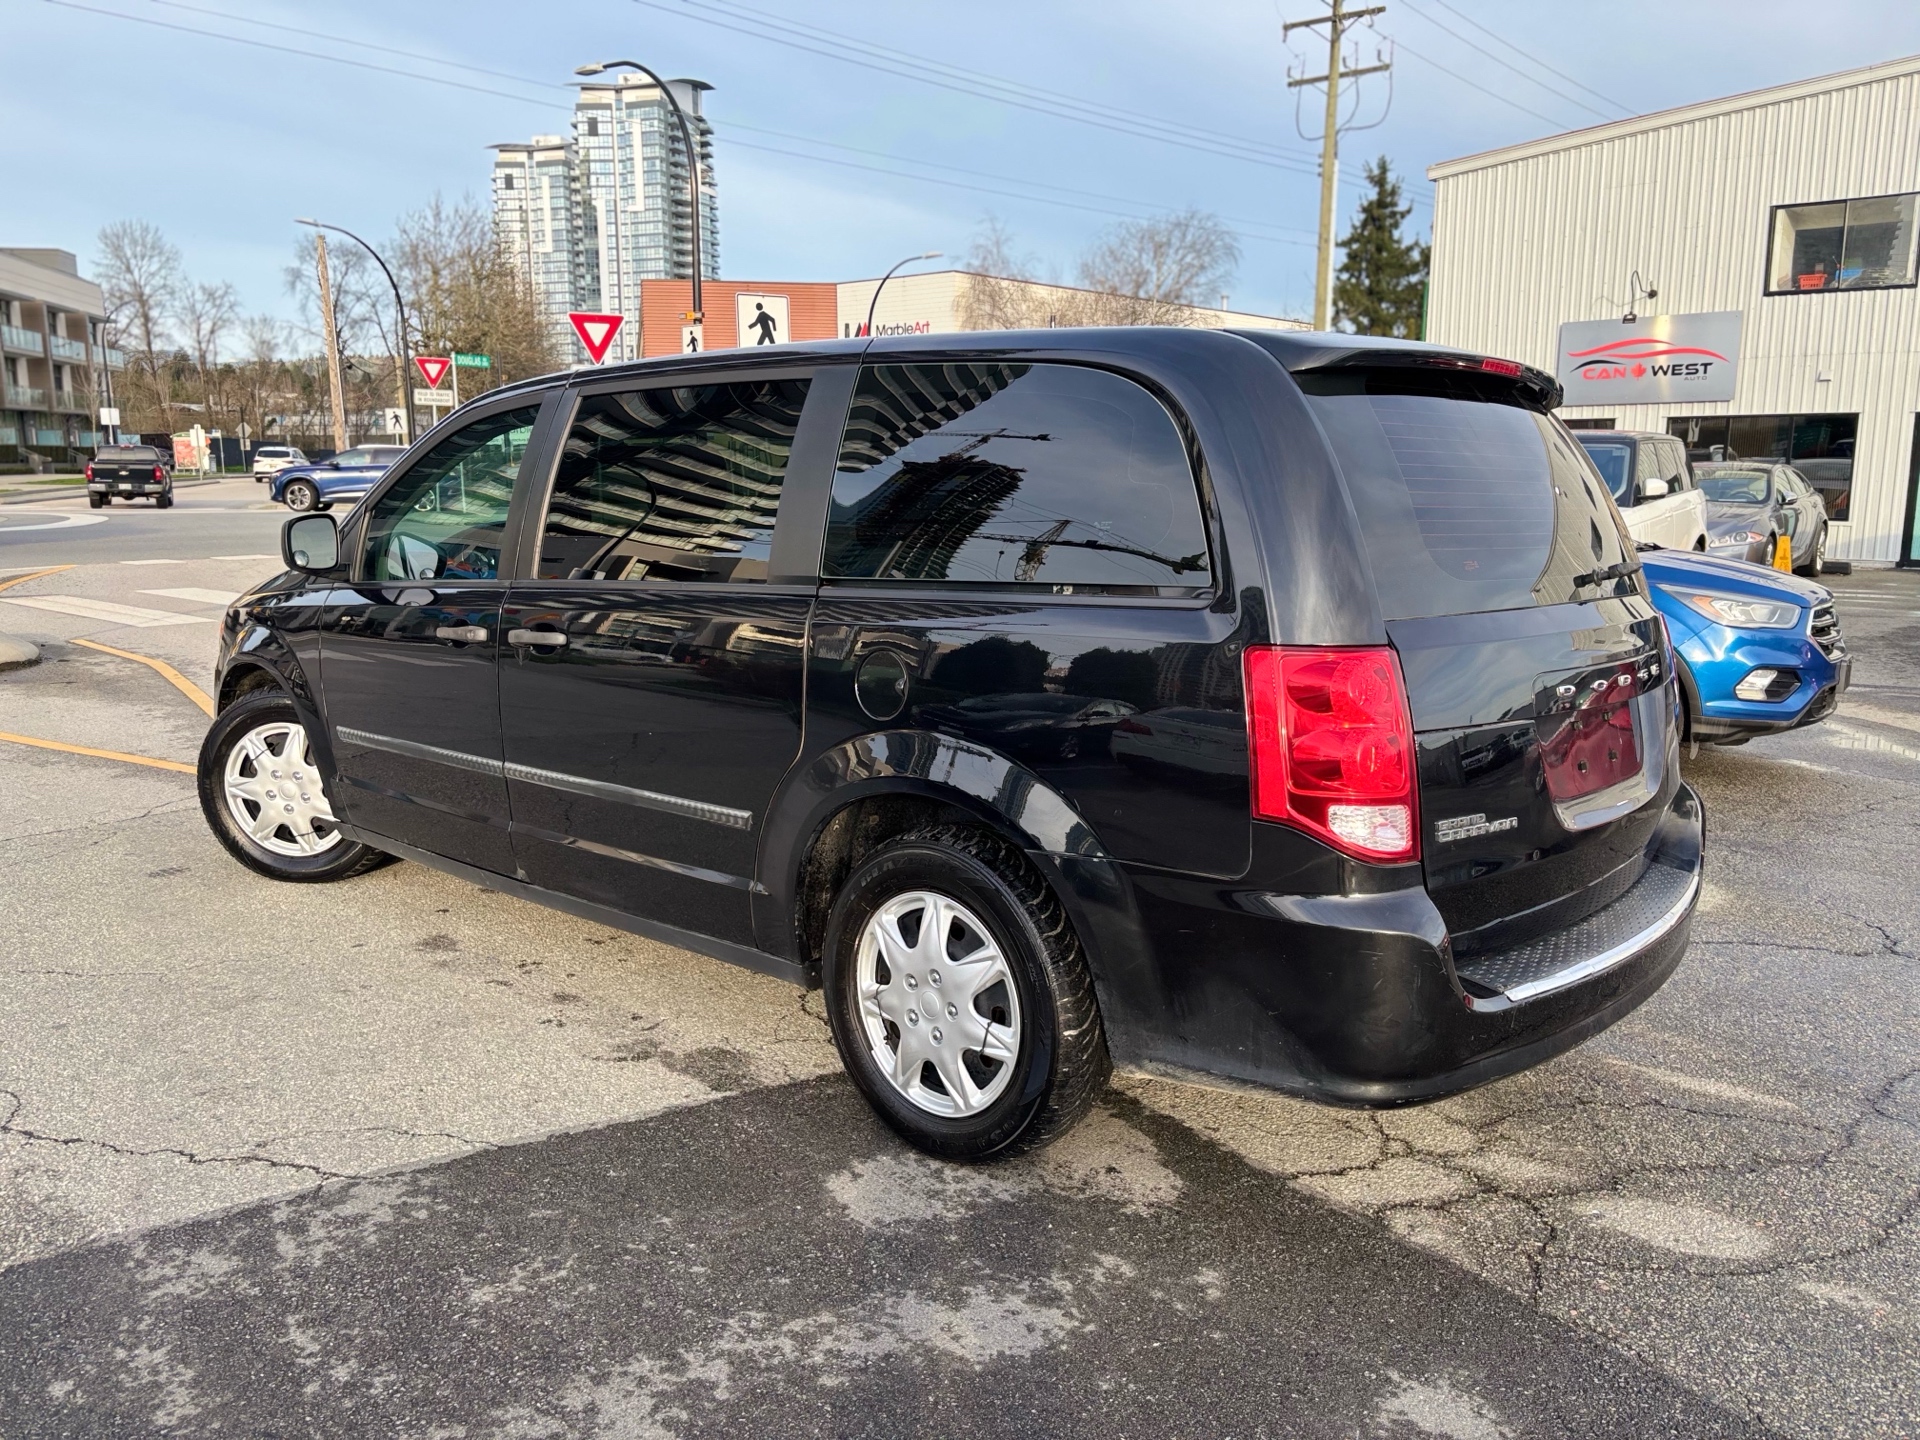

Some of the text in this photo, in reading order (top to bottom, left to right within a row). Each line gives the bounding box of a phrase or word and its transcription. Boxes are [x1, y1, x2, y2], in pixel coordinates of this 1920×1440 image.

[876, 321, 931, 337] MarbleArt
[457, 355, 481, 367] DOUGLAS
[1582, 362, 1714, 381] CAN WEST
[1556, 663, 1660, 698] DODGE
[1434, 812, 1486, 832] GRAND
[1435, 816, 1518, 843] CARAVAN
